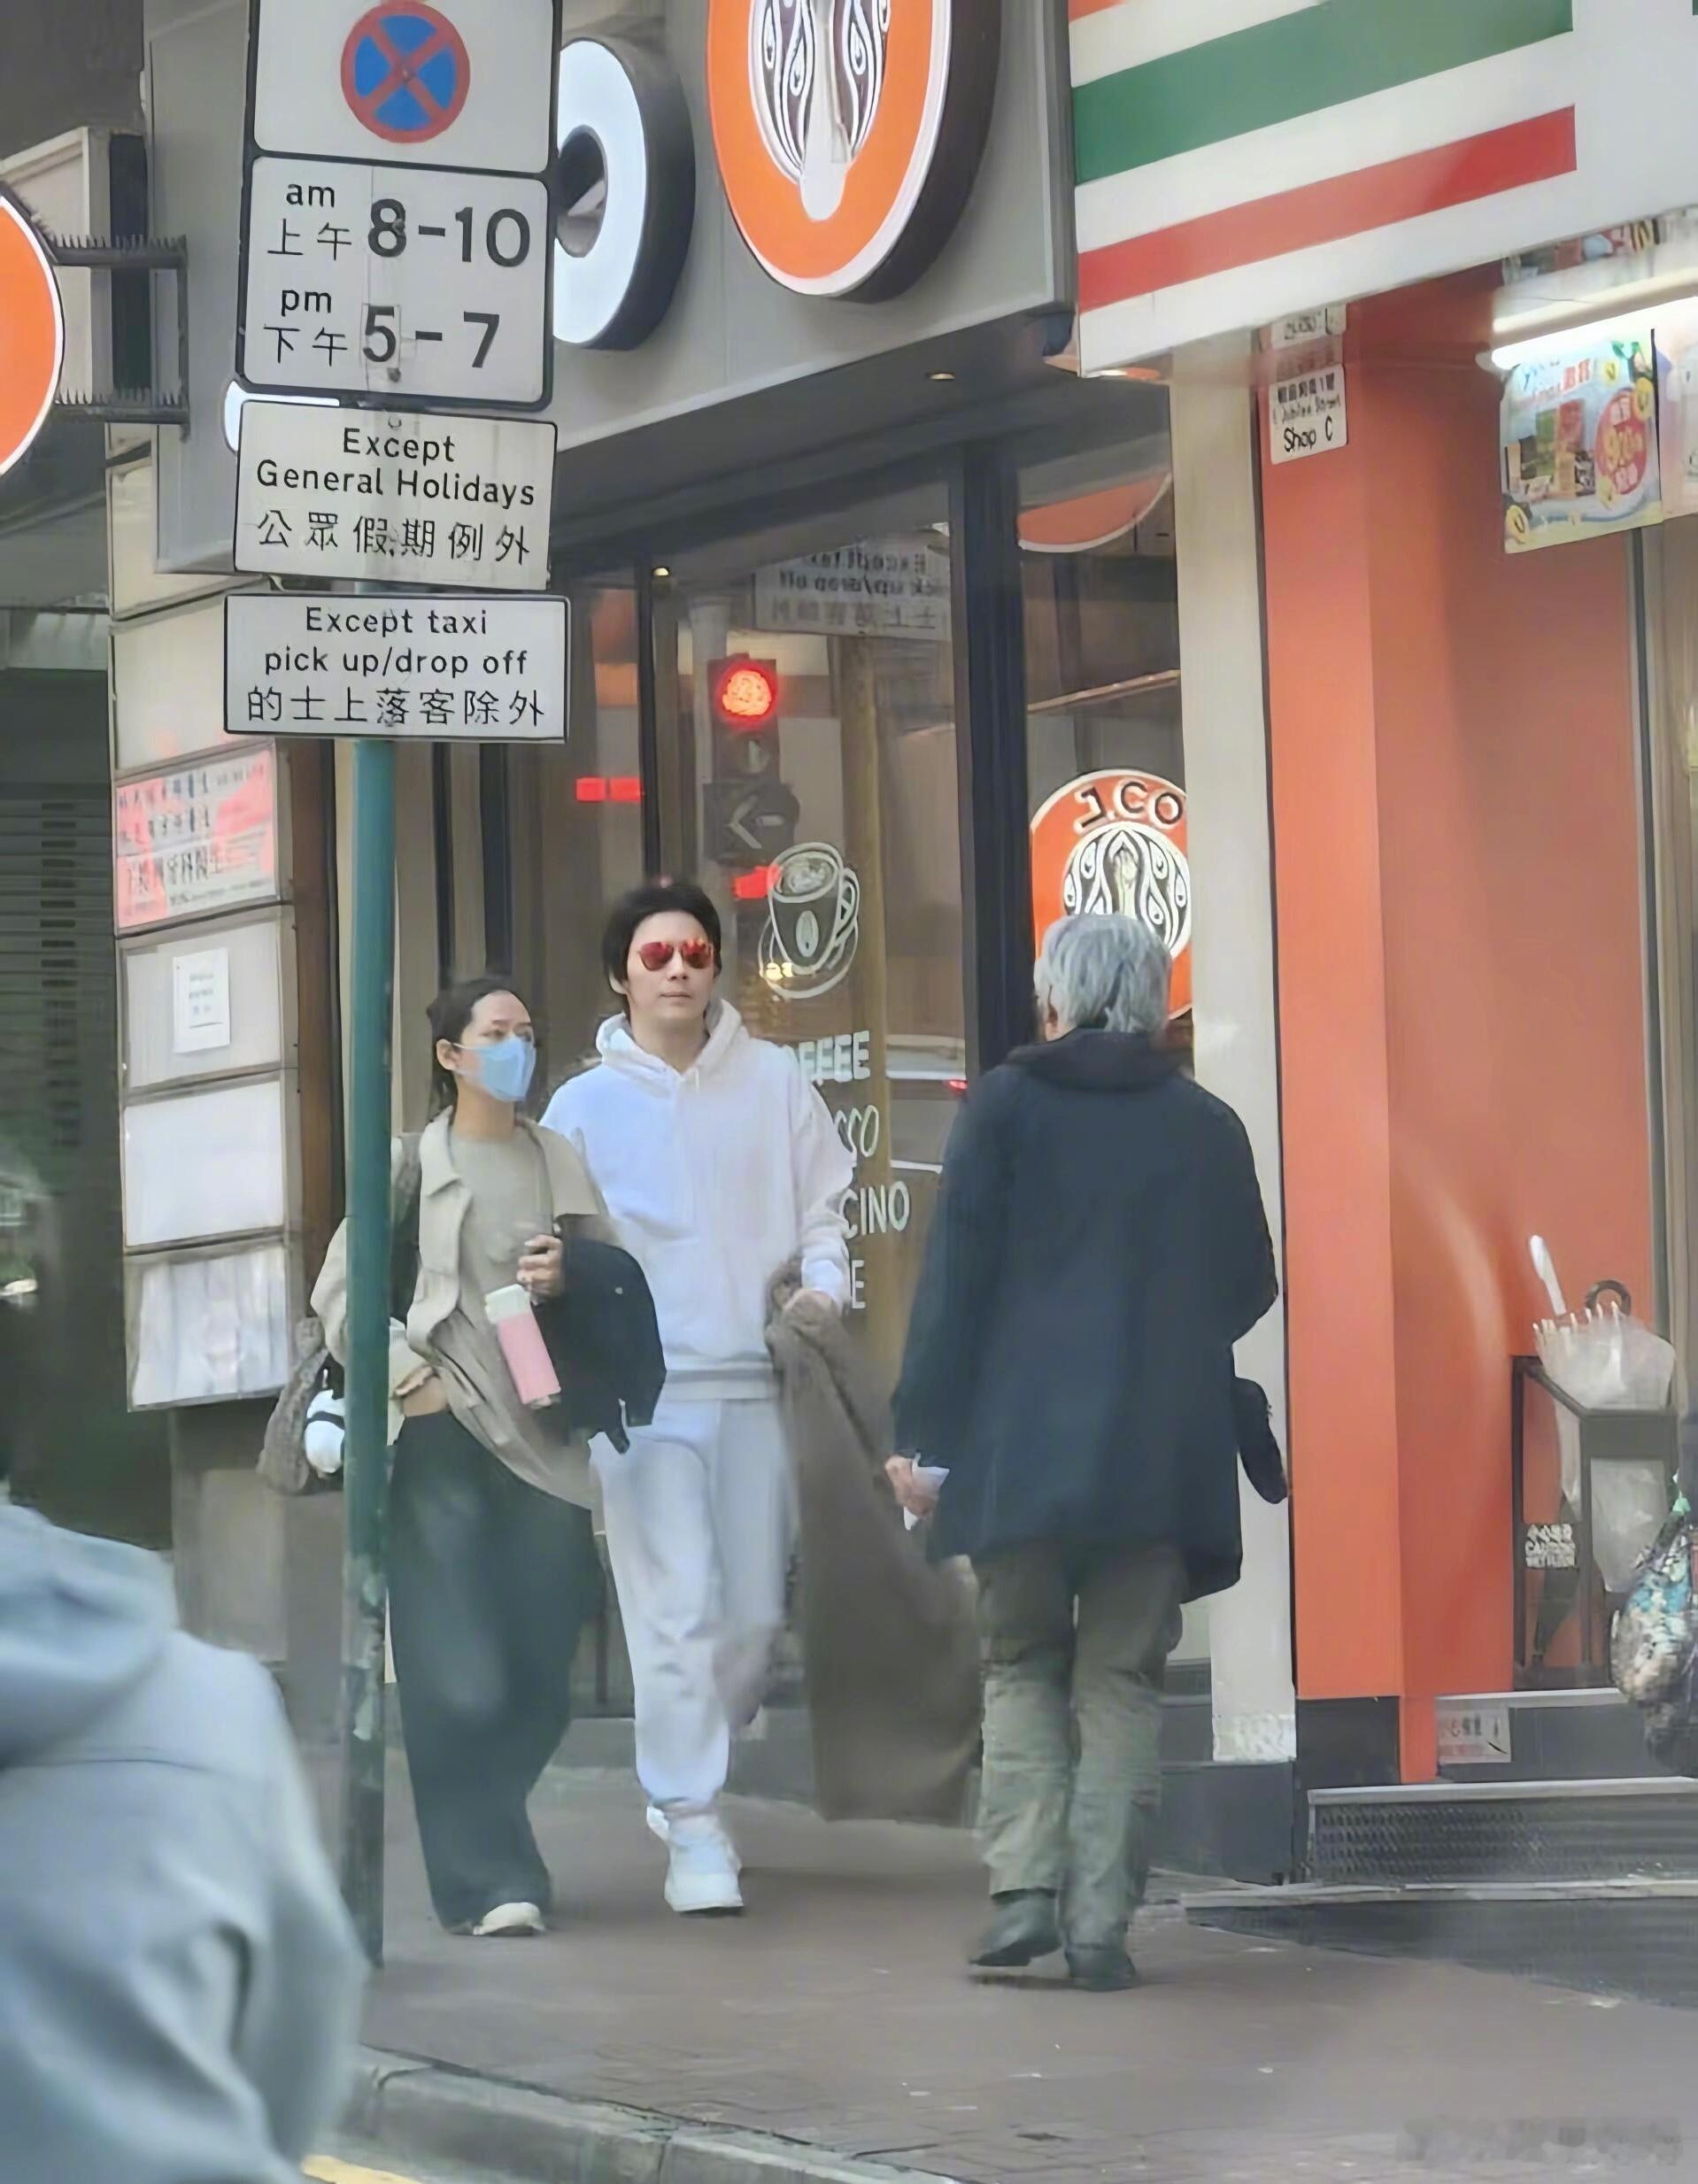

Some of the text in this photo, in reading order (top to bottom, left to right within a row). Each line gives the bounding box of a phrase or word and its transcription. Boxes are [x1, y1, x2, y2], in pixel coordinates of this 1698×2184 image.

[286, 183, 336, 208] am
[266, 218, 352, 261] 上午
[281, 289, 332, 317] pm
[263, 324, 349, 367] 下午
[343, 427, 456, 467] Except
[1324, 414, 1334, 442] C
[257, 459, 536, 510] General Holidays
[258, 509, 530, 566] 公眾假期例外
[305, 606, 488, 638] Except taxi
[265, 644, 529, 678] pick up/drop off
[247, 685, 545, 728] 的士上落客除外
